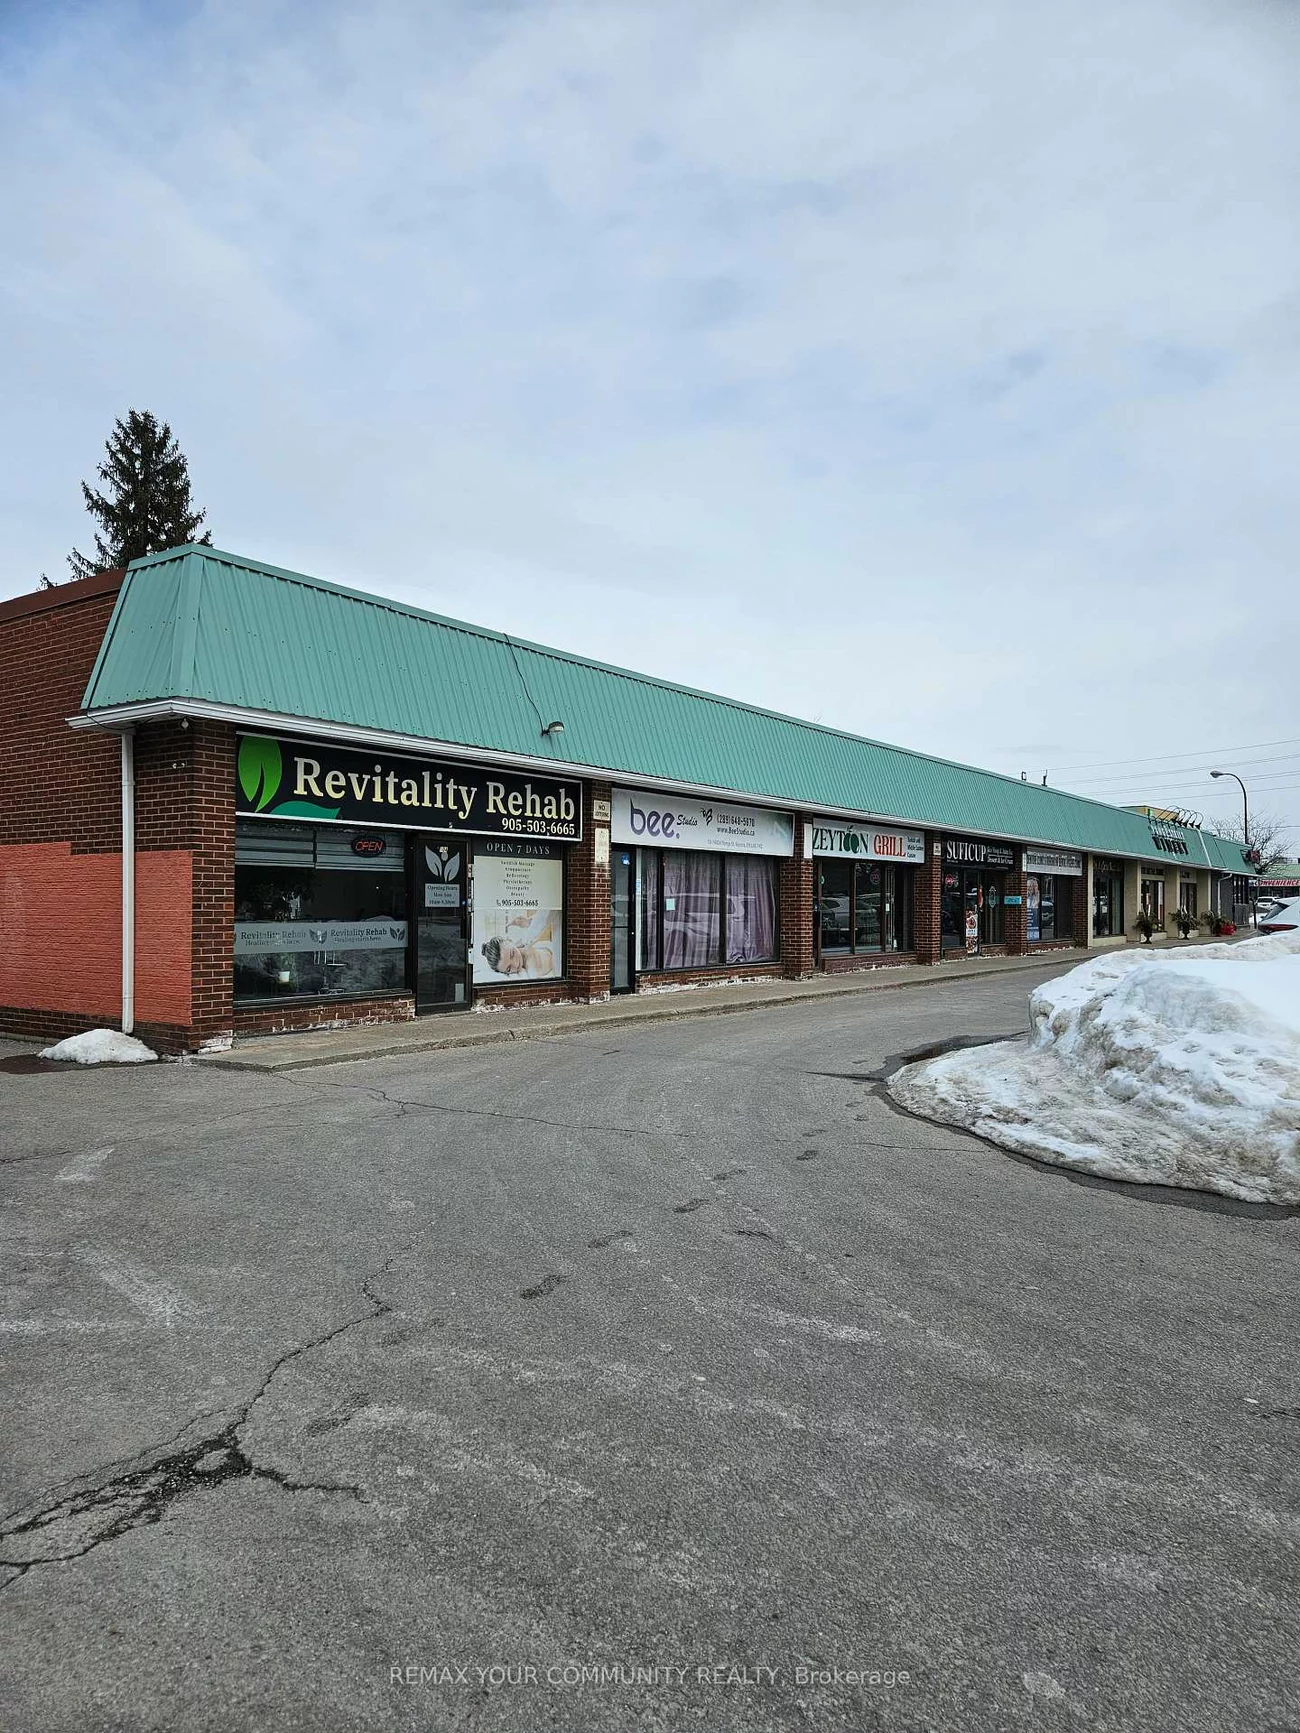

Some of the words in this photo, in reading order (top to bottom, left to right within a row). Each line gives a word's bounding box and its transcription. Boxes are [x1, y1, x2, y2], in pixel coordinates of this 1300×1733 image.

[294, 757, 477, 820] Revitality
[486, 781, 575, 820] Rehab
[501, 817, 575, 836] 905-503-6665
[676, 814, 698, 827] Studio
[355, 841, 383, 852] OPEN
[486, 842, 513, 852] OPEN
[516, 845, 522, 854] 7
[525, 845, 550, 855] DAYS
[873, 833, 906, 857] GRILL
[946, 840, 986, 862] SUFICUP
[501, 898, 539, 907] 905-503-6665
[330, 928, 365, 938] Revitality
[366, 926, 388, 936] Rehab
